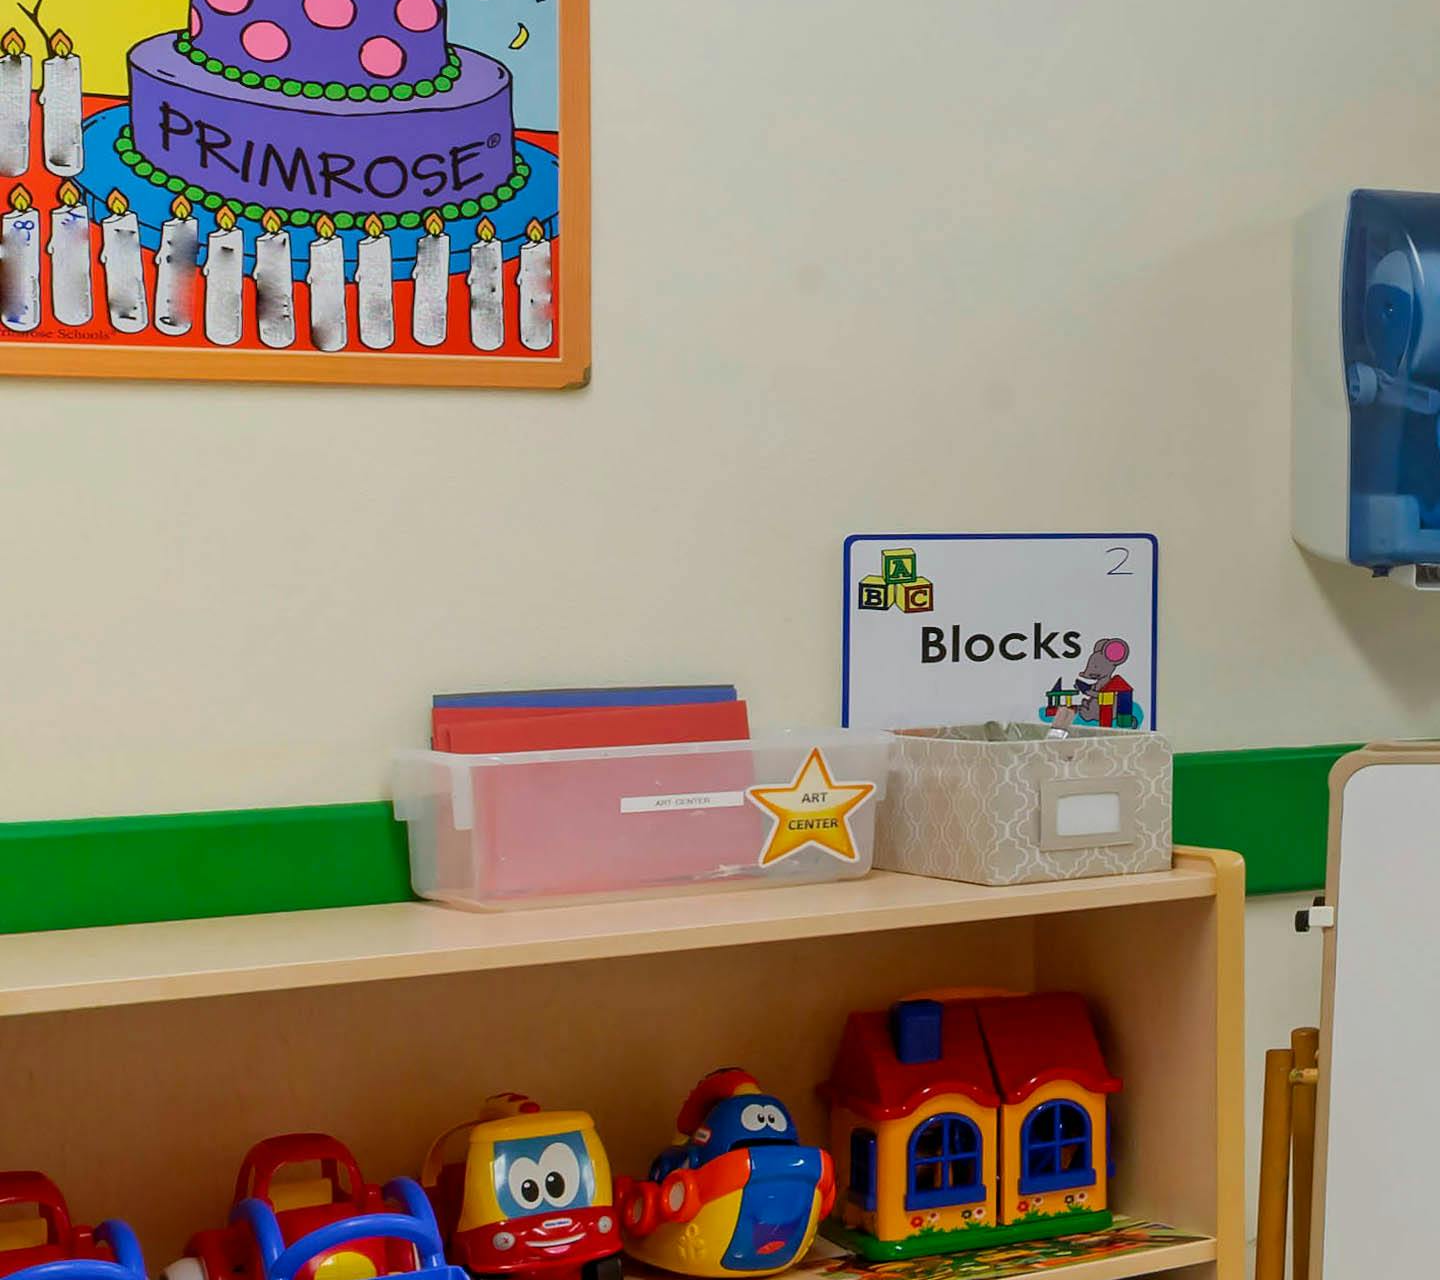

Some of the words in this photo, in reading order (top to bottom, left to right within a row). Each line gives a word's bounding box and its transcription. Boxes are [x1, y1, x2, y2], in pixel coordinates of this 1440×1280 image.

[1105, 546, 1134, 575] 2
[921, 622, 1082, 664] Blocks
[801, 792, 828, 804] ART
[788, 817, 839, 831] CENTER
